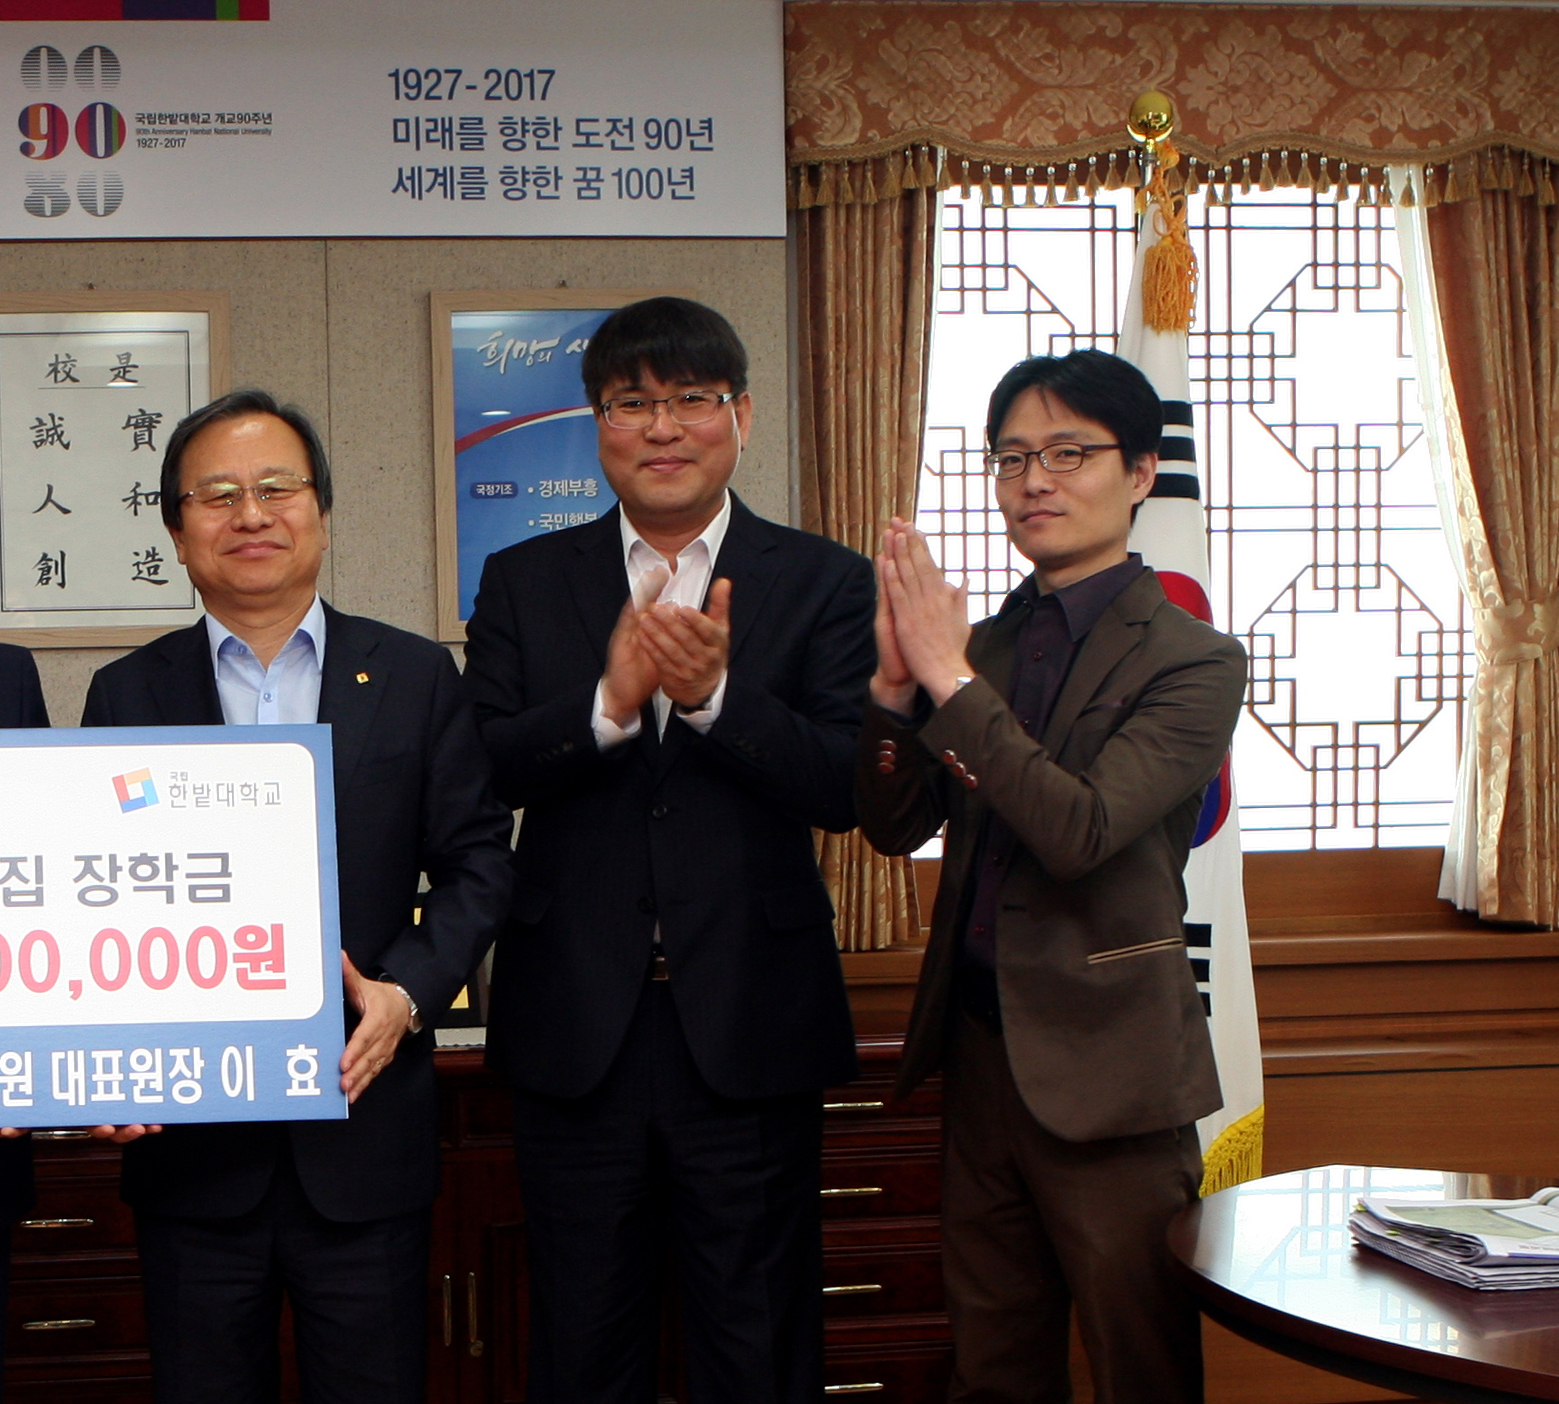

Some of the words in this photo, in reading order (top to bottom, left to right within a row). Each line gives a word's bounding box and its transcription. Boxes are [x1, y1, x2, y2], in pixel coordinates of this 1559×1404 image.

[18, 101, 127, 161] 90
[135, 112, 211, 125] 국립한밭대학교
[215, 112, 273, 125] 개교90주년
[152, 128, 189, 136] Anniversary
[241, 128, 272, 136] University
[392, 116, 488, 151] 미래를
[498, 116, 563, 151] 향한
[572, 117, 636, 151] 도전
[643, 117, 714, 151] 90년
[391, 165, 489, 201] 세계를
[498, 165, 563, 200] 향한
[573, 166, 605, 200] 꿈
[612, 165, 696, 200] 100년
[476, 330, 561, 375] 희망의
[476, 484, 513, 496] 국정기조
[539, 478, 599, 498] 경제부흥
[168, 782, 282, 808] 한밭대학교
[73, 852, 233, 907] 장학금
[51, 1045, 205, 1107] 대표원장
[220, 1044, 255, 1101] 이
[285, 1044, 322, 1097] 효
